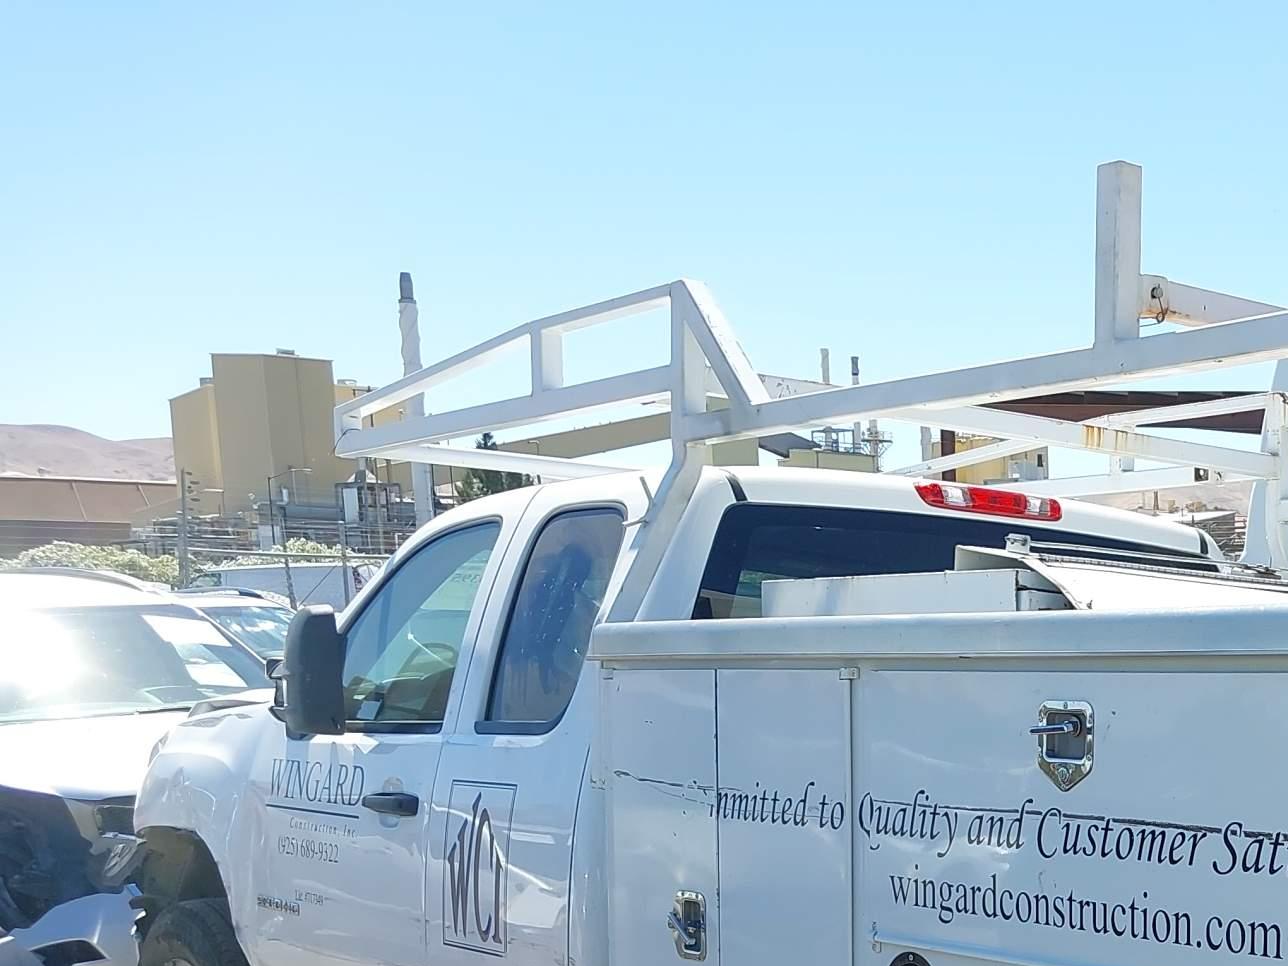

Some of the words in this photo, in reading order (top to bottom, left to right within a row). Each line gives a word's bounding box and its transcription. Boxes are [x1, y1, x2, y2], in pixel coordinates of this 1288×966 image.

[270, 742, 365, 807] WINGARD
[448, 791, 506, 945] WCI
[709, 781, 815, 827] mmitted
[819, 794, 845, 830] to
[859, 789, 959, 858] Quality
[967, 799, 1034, 850] and
[1037, 807, 1208, 867] Customer
[889, 864, 1284, 960] wingardconstruction.com
